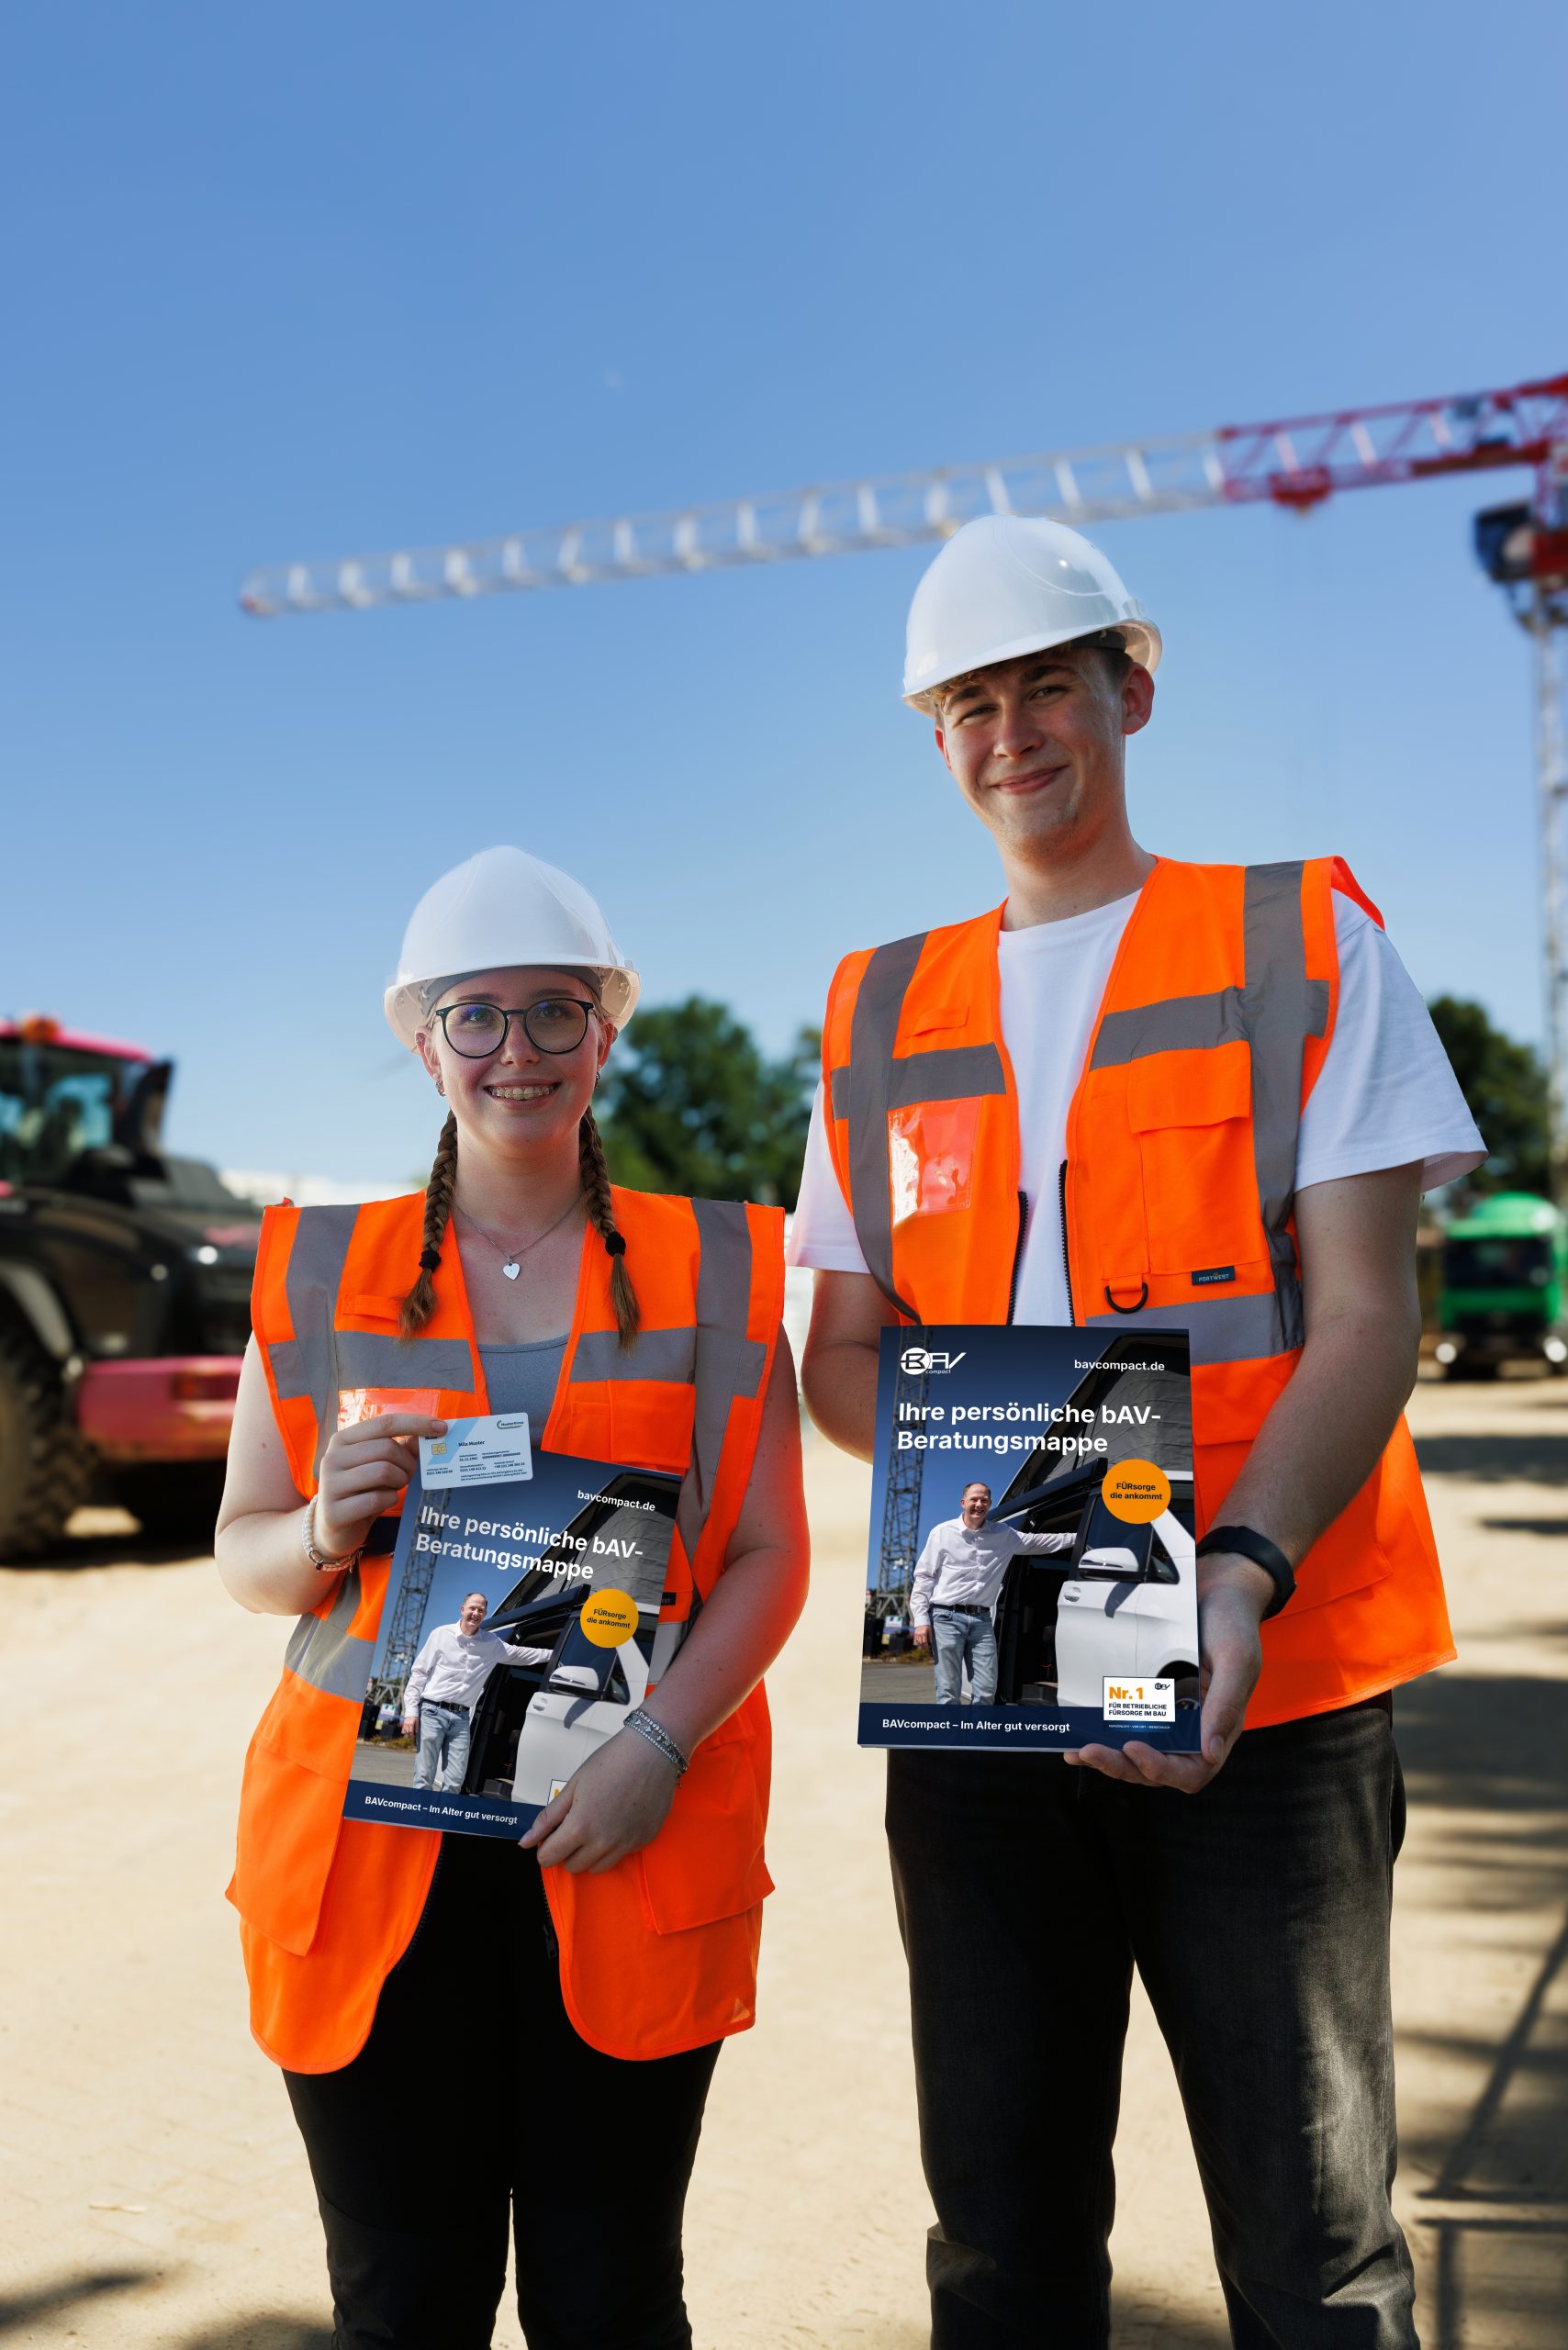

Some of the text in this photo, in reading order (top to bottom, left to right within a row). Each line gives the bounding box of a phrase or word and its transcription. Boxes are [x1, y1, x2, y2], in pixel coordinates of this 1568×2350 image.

[1198, 1273, 1230, 1282] PORTWEST
[900, 1347, 967, 1375] BAV
[1074, 1359, 1165, 1372] bavcompact.de
[899, 1402, 1161, 1425] Ihre persönliche bAV-
[897, 1431, 1108, 1456] Beratungsmappe
[1116, 1481, 1156, 1492] FÜRsorge
[577, 1490, 655, 1512] bavcompact.de
[420, 1505, 644, 1559] Ihre persönliche bAV-
[415, 1532, 594, 1581] Beratungsmappe
[593, 1607, 627, 1620] FÜRsorge
[599, 1619, 631, 1628] ankommt
[1109, 1686, 1143, 1700] Nr. 1
[882, 1718, 950, 1731] BAVcompact
[960, 1720, 974, 1729] Im
[976, 1721, 1002, 1730] Alter
[1004, 1722, 1023, 1732] gut
[1025, 1722, 1070, 1733] versorgt
[364, 1796, 421, 1811] BAVcompact
[429, 1805, 441, 1814] Im
[442, 1807, 464, 1817] Alter
[465, 1810, 480, 1820] gut
[481, 1813, 518, 1826] versorgt
